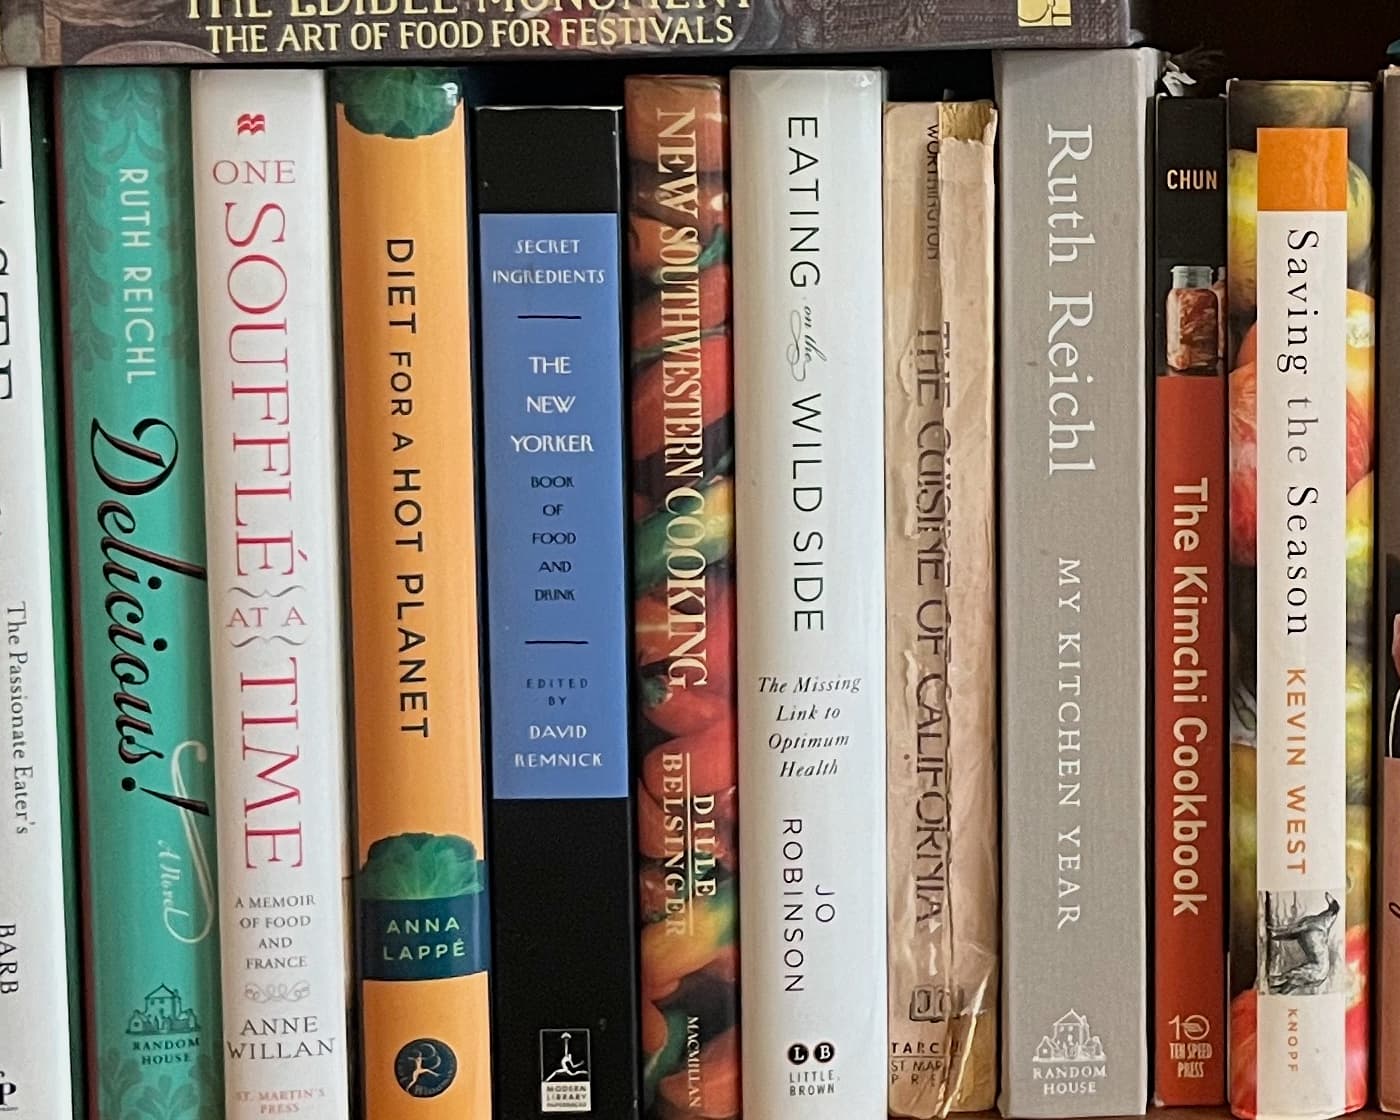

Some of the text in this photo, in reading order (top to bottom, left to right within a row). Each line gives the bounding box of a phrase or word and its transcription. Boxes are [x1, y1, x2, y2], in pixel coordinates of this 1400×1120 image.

[205, 14, 735, 54] THE ART OF FOOD FOR FESTIVALS
[212, 159, 296, 185] ONE
[1167, 170, 1217, 190] CHUN
[787, 115, 821, 288] EATING
[515, 239, 580, 254] SECRET
[119, 167, 156, 384] RUTH REICHL
[492, 269, 605, 285] INGREDIENTS
[1047, 123, 1096, 476] Ruth Reichl
[803, 305, 813, 328] on
[528, 356, 572, 374] THE
[224, 201, 309, 576] SOUFFLÉ
[656, 107, 707, 689] NEW SOUTHWESTERN COOKING
[526, 395, 576, 414] NEW
[510, 435, 594, 452] YORKER
[791, 392, 823, 513] WILD
[386, 238, 429, 738] DIET FOR A HOT PLANET
[530, 475, 575, 489] BOOK
[542, 503, 564, 517] OF
[531, 531, 577, 545] FOOD
[1276, 230, 1319, 874] Saving the Season KEVIN WEST
[538, 560, 572, 573] AND
[793, 530, 825, 633] SIDE
[534, 588, 575, 602] DRINK
[91, 417, 210, 816] Delicious!
[226, 606, 306, 628] AT A
[526, 678, 589, 689] EDITED
[758, 674, 862, 695] The Missing
[548, 696, 567, 706] BY
[1173, 478, 1208, 917] The Kimchi Cookbook
[6, 601, 35, 835] The Passionate Eater's
[776, 704, 841, 722] Link to
[529, 725, 587, 739] DAVID
[767, 732, 850, 752] Optimum
[1057, 557, 1081, 930] MY KITCHEN YEAR
[239, 657, 303, 869] TIME
[514, 752, 603, 767] REMNICK
[779, 758, 839, 778] Health
[662, 752, 686, 938] BELSINGER
[693, 792, 717, 898] DILLE
[234, 895, 316, 909] A MEMOIR
[782, 819, 805, 993] ROBINSON
[815, 884, 836, 924] JO
[240, 914, 312, 928] OF FOOD
[386, 917, 460, 933] ANNA
[258, 936, 293, 949] AND
[383, 938, 465, 961] LAPPÉ
[0, 924, 19, 994] BARB
[245, 957, 308, 969] FRANCE
[240, 1016, 319, 1035] ANNE
[132, 1036, 201, 1065] RANDOM HOUSE
[226, 1037, 336, 1060] WILLAN
[1170, 1042, 1212, 1059] TEN SPEED
[1287, 1008, 1298, 1073] KNOPF
[687, 1015, 703, 1108] MACMILLAN
[1178, 1061, 1204, 1078] PRESS
[1032, 1065, 1107, 1081] RANDOM
[789, 1083, 835, 1096] BROWN
[1043, 1080, 1097, 1095] HOUSE
[260, 1102, 300, 1115] PRESS
